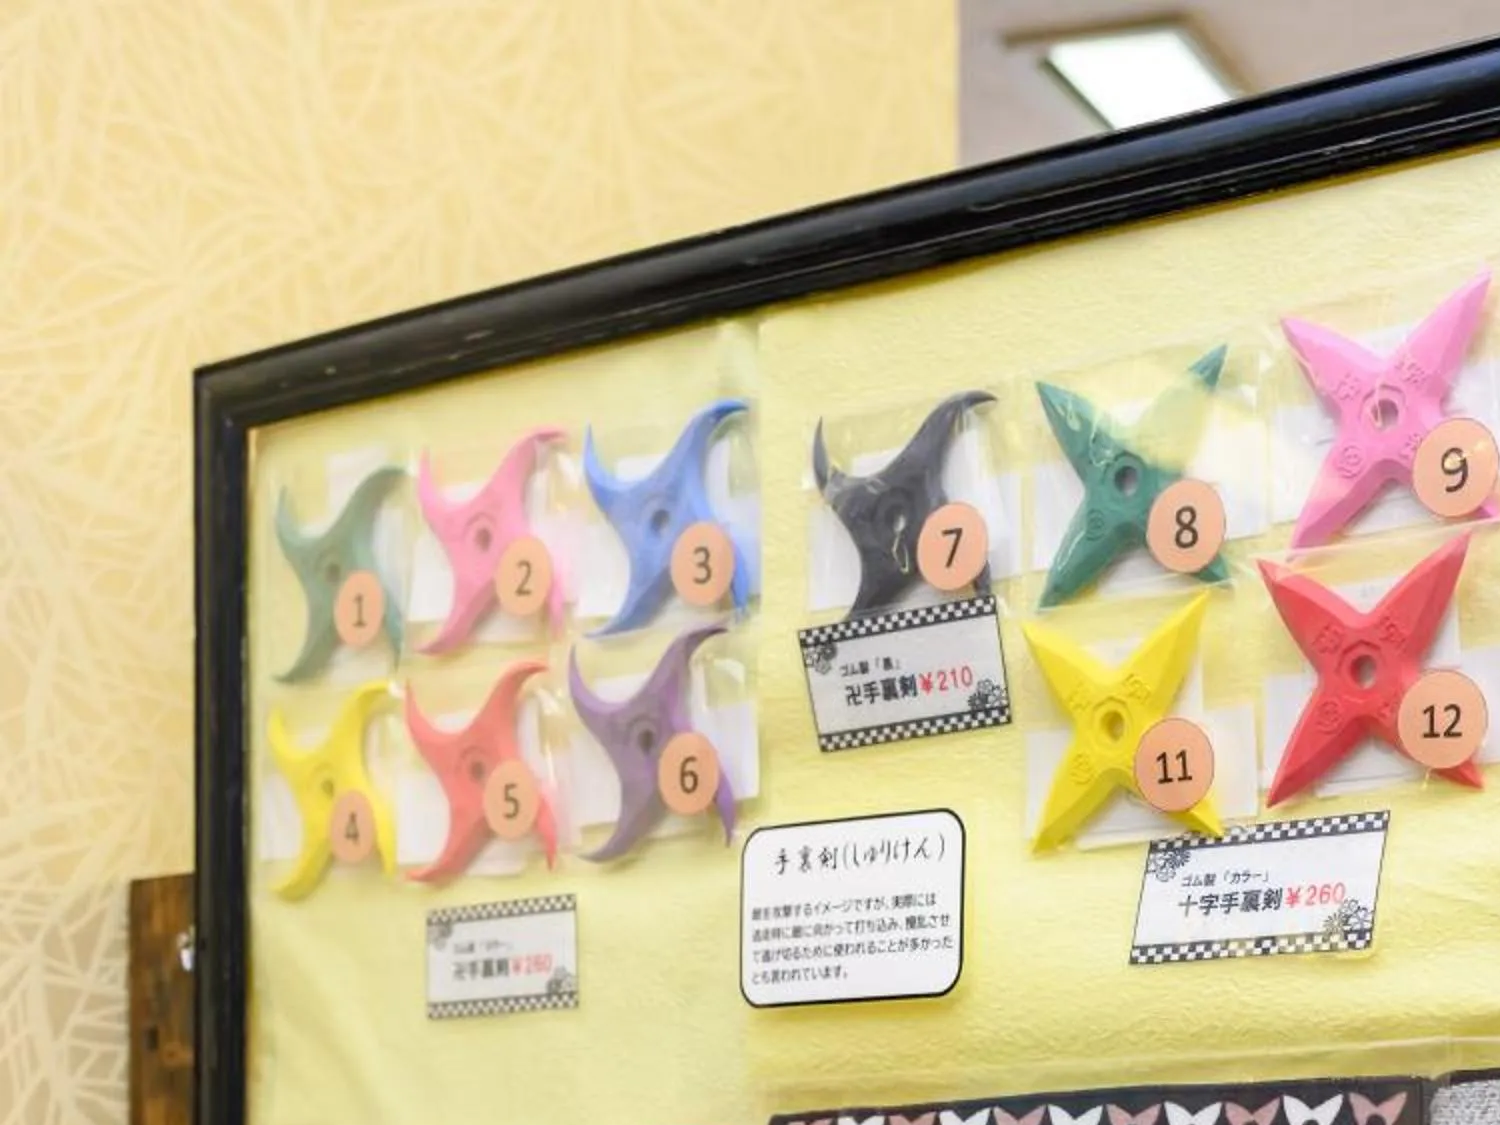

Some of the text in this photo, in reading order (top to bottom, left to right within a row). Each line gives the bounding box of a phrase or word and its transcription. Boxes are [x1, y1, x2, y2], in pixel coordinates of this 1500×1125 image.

[1441, 447, 1468, 493] 9
[1174, 506, 1198, 549] 8
[693, 547, 711, 584] 3
[941, 527, 964, 568] 7
[515, 559, 532, 596] 2
[353, 594, 366, 628] 1
[1422, 704, 1462, 738] 12
[680, 756, 699, 793] 6
[1156, 749, 1193, 784] 11
[504, 784, 519, 818] 5
[345, 813, 359, 844] 4
